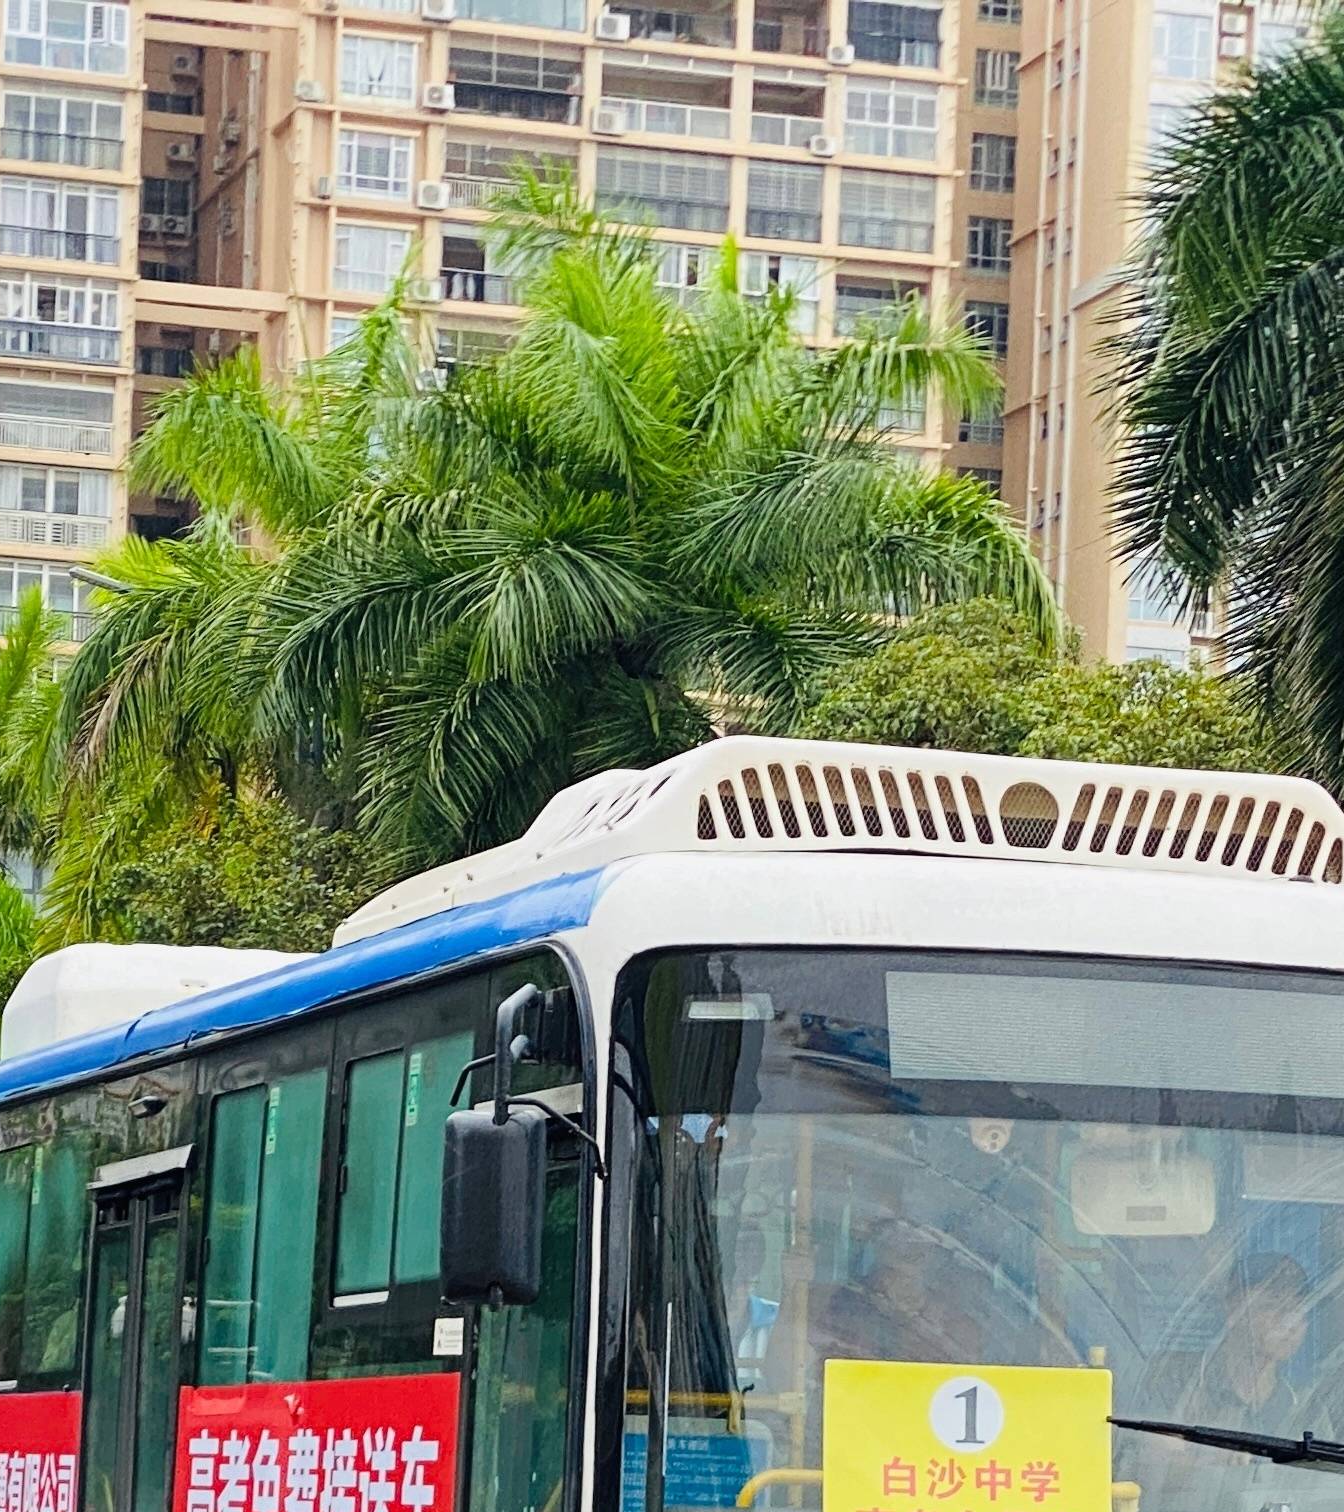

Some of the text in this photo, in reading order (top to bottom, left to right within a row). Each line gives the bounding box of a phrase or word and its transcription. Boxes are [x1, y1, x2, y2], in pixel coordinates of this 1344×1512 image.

[954, 1385, 985, 1444] 1
[883, 1456, 1061, 1502] 白沙中学
